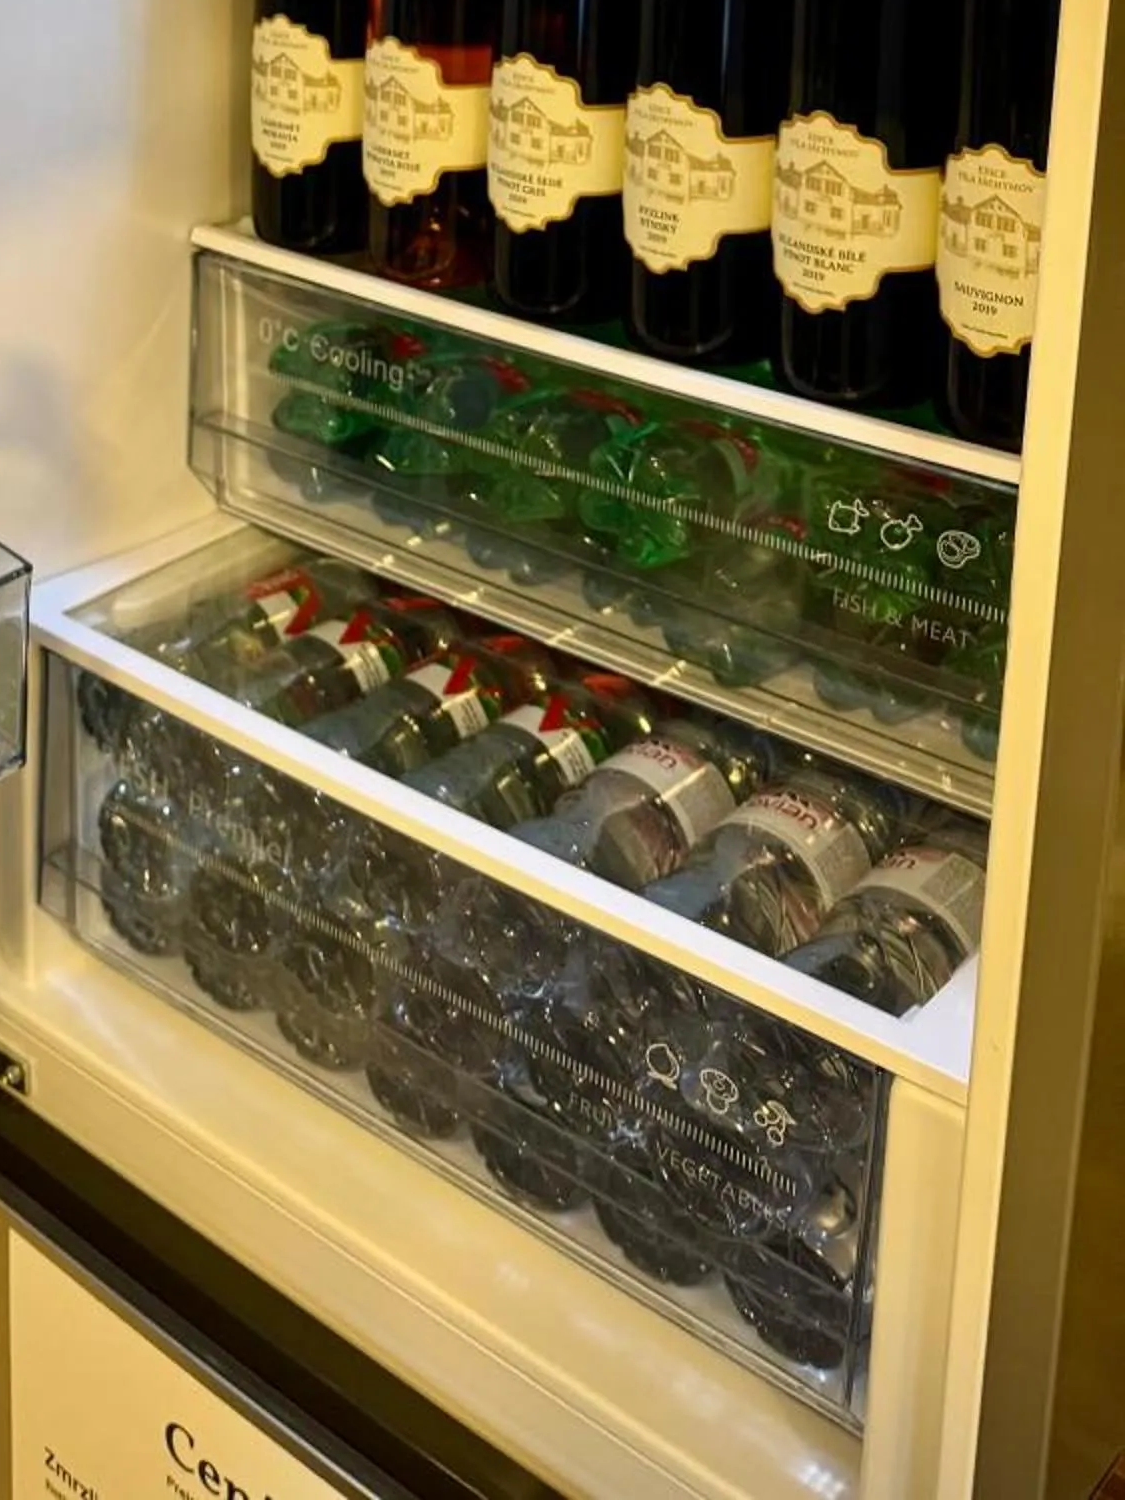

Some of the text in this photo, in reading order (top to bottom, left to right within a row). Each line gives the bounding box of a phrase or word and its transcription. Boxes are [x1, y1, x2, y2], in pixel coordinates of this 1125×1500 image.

[954, 280, 1025, 308] SAUVIGNON
[972, 301, 999, 317] 2019
[911, 614, 972, 648] MEAT
[568, 1090, 613, 1128] FRUI
[165, 1421, 272, 1500] Cen
